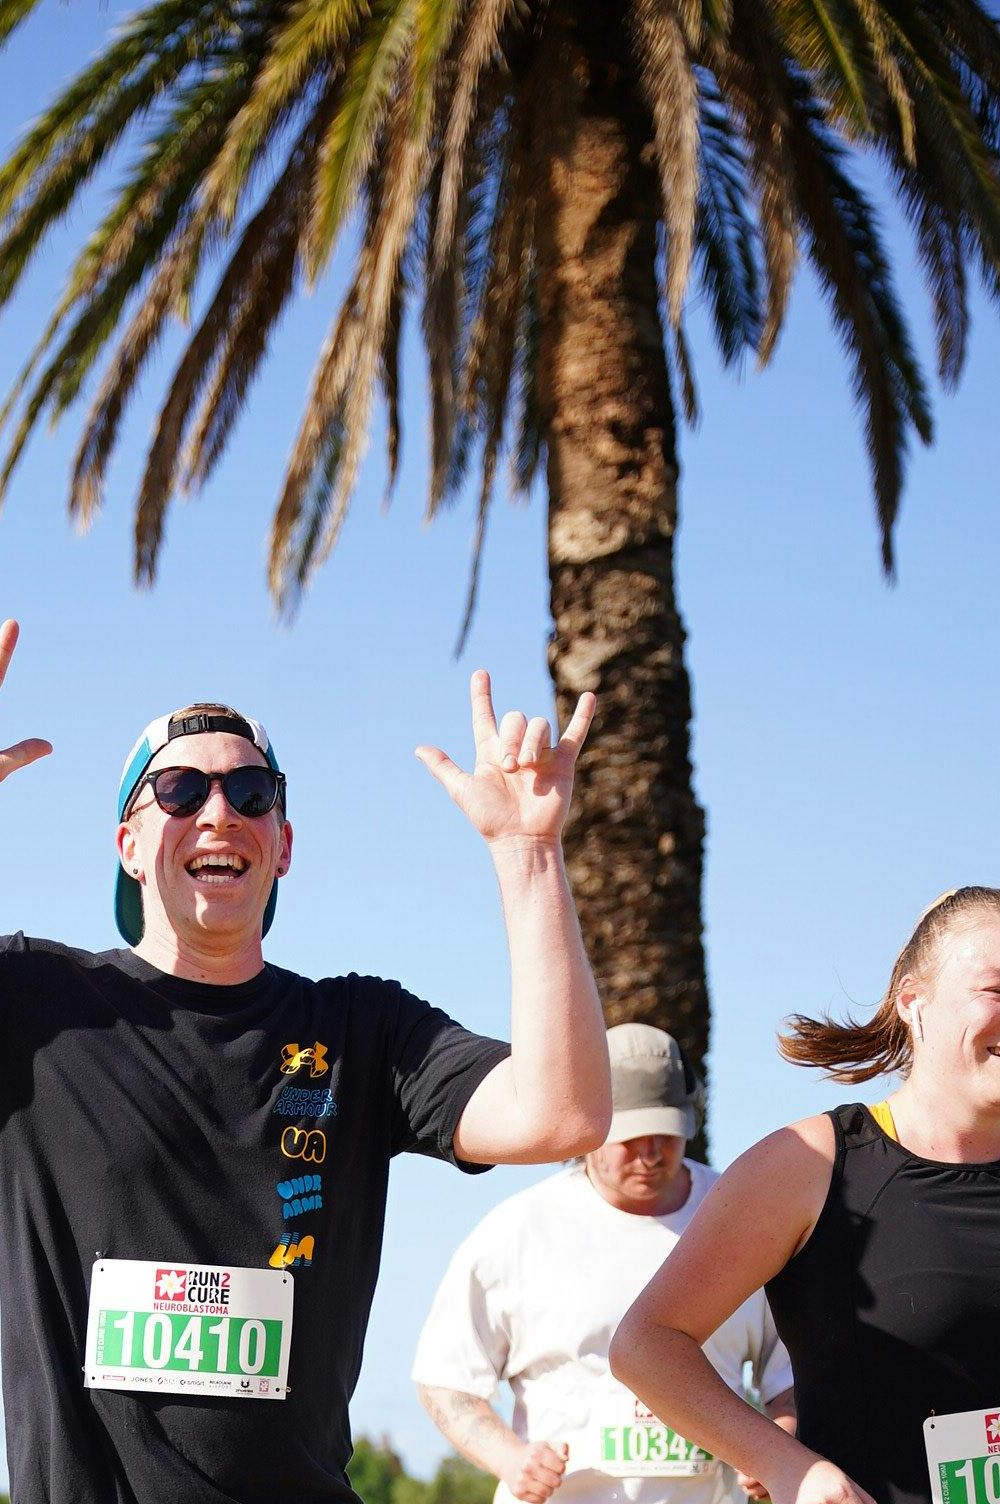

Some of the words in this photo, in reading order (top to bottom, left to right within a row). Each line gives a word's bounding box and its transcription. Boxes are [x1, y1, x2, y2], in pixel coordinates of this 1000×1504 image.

[281, 1086, 333, 1102] UNDER
[273, 1099, 337, 1117] ARMOUR
[280, 1126, 326, 1163] UA
[187, 1286, 230, 1304] CURE
[153, 1302, 229, 1315] NEUROBLASTOMA
[113, 1311, 267, 1375] 10410
[942, 1480, 950, 1496] CURE
